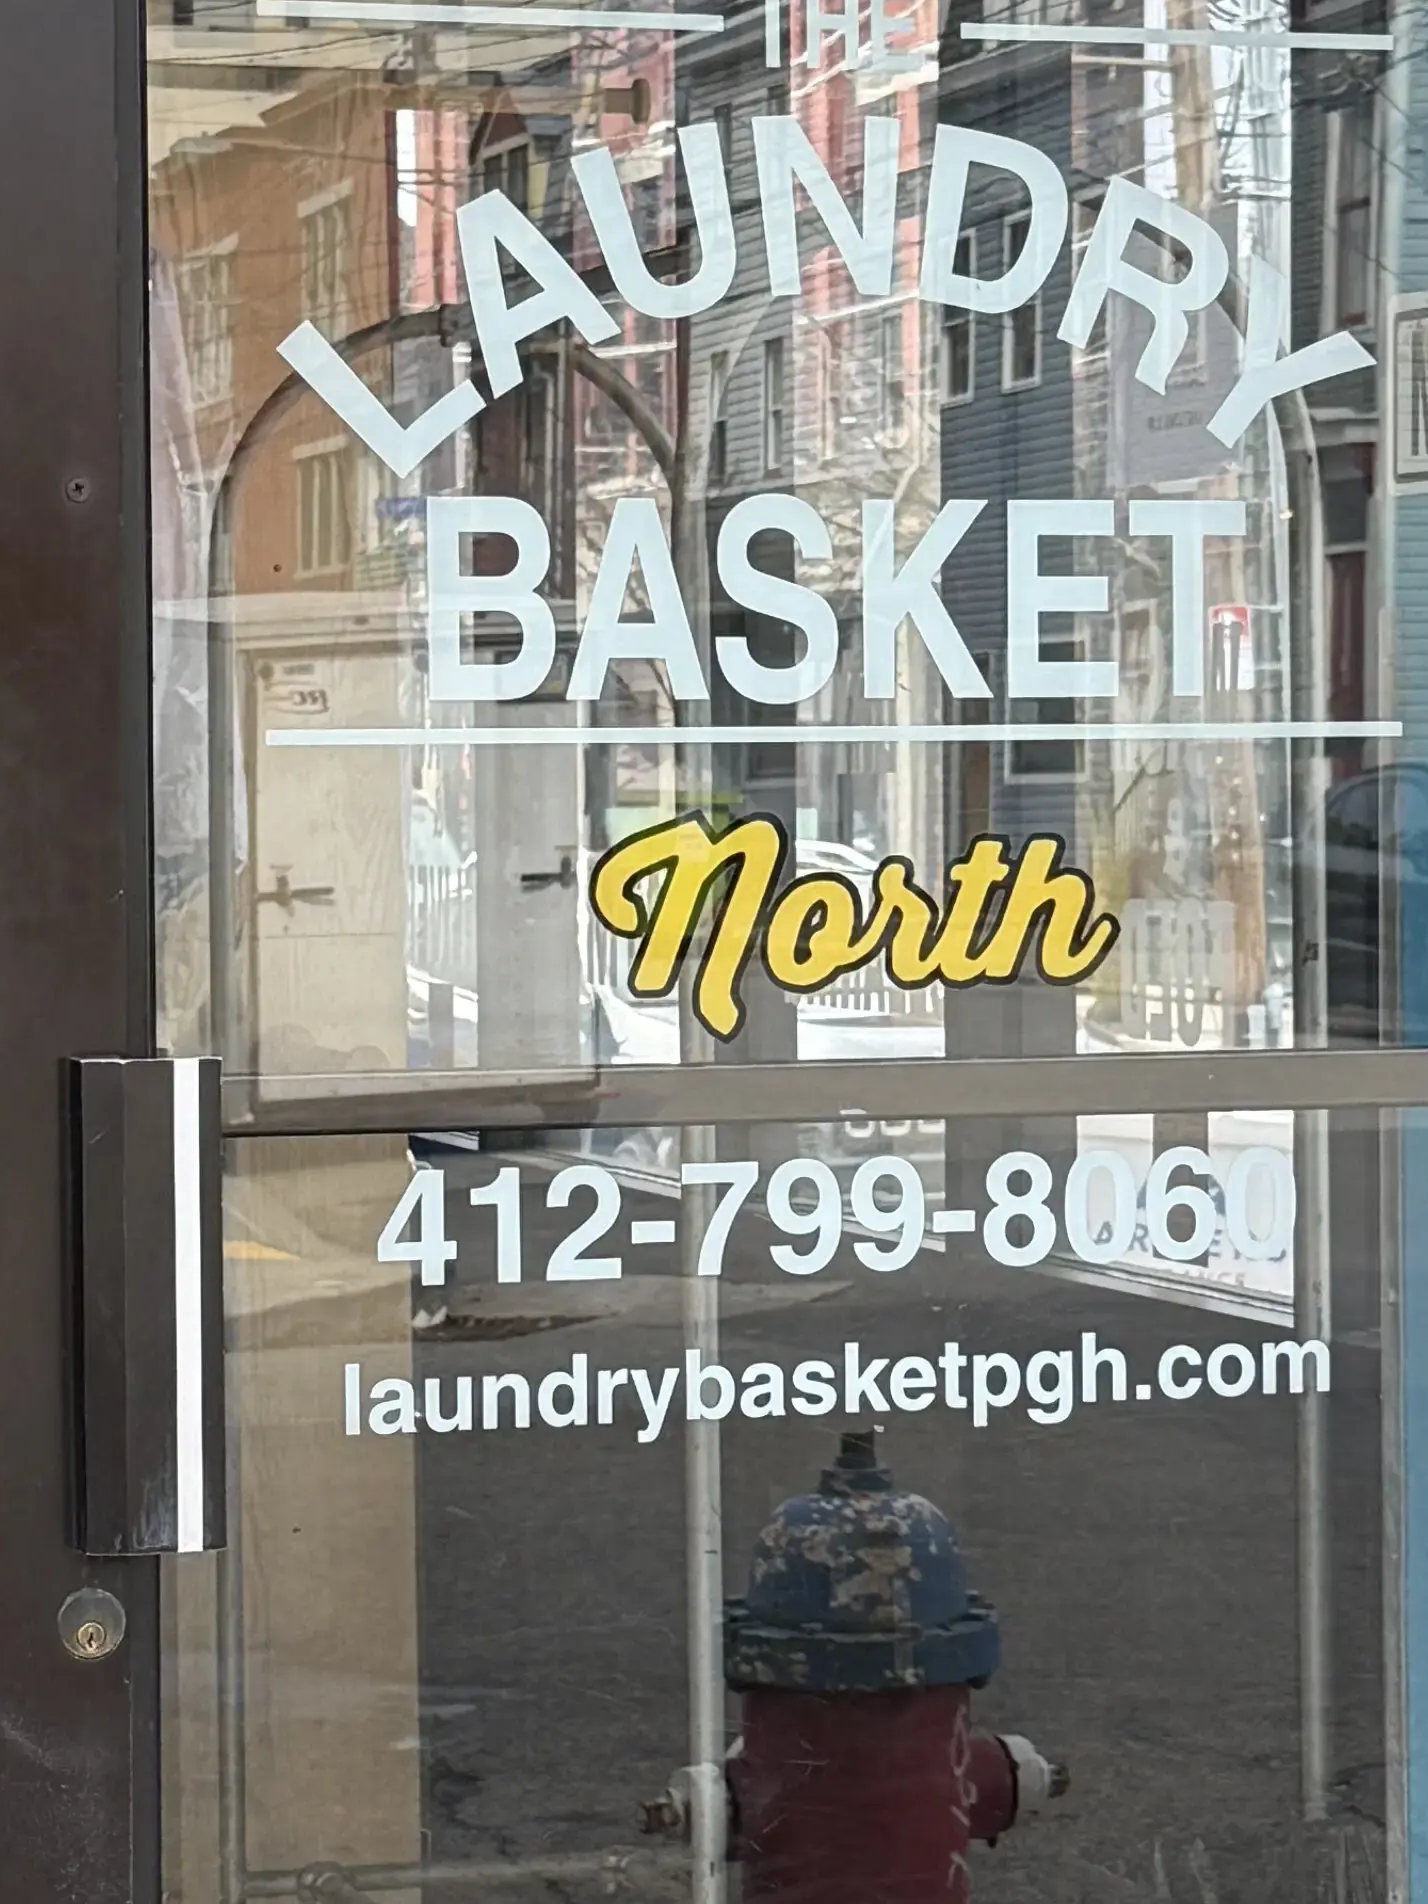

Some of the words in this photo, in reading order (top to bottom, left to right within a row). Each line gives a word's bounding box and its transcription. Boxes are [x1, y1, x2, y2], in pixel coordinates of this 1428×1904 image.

[275, 114, 1377, 478] LAUNDRY
[426, 492, 1246, 703] BASKET
[589, 810, 1122, 1042] North
[376, 1145, 1298, 1287] 412-799-8060
[343, 1329, 1331, 1444] laundrybasketpgh.com
